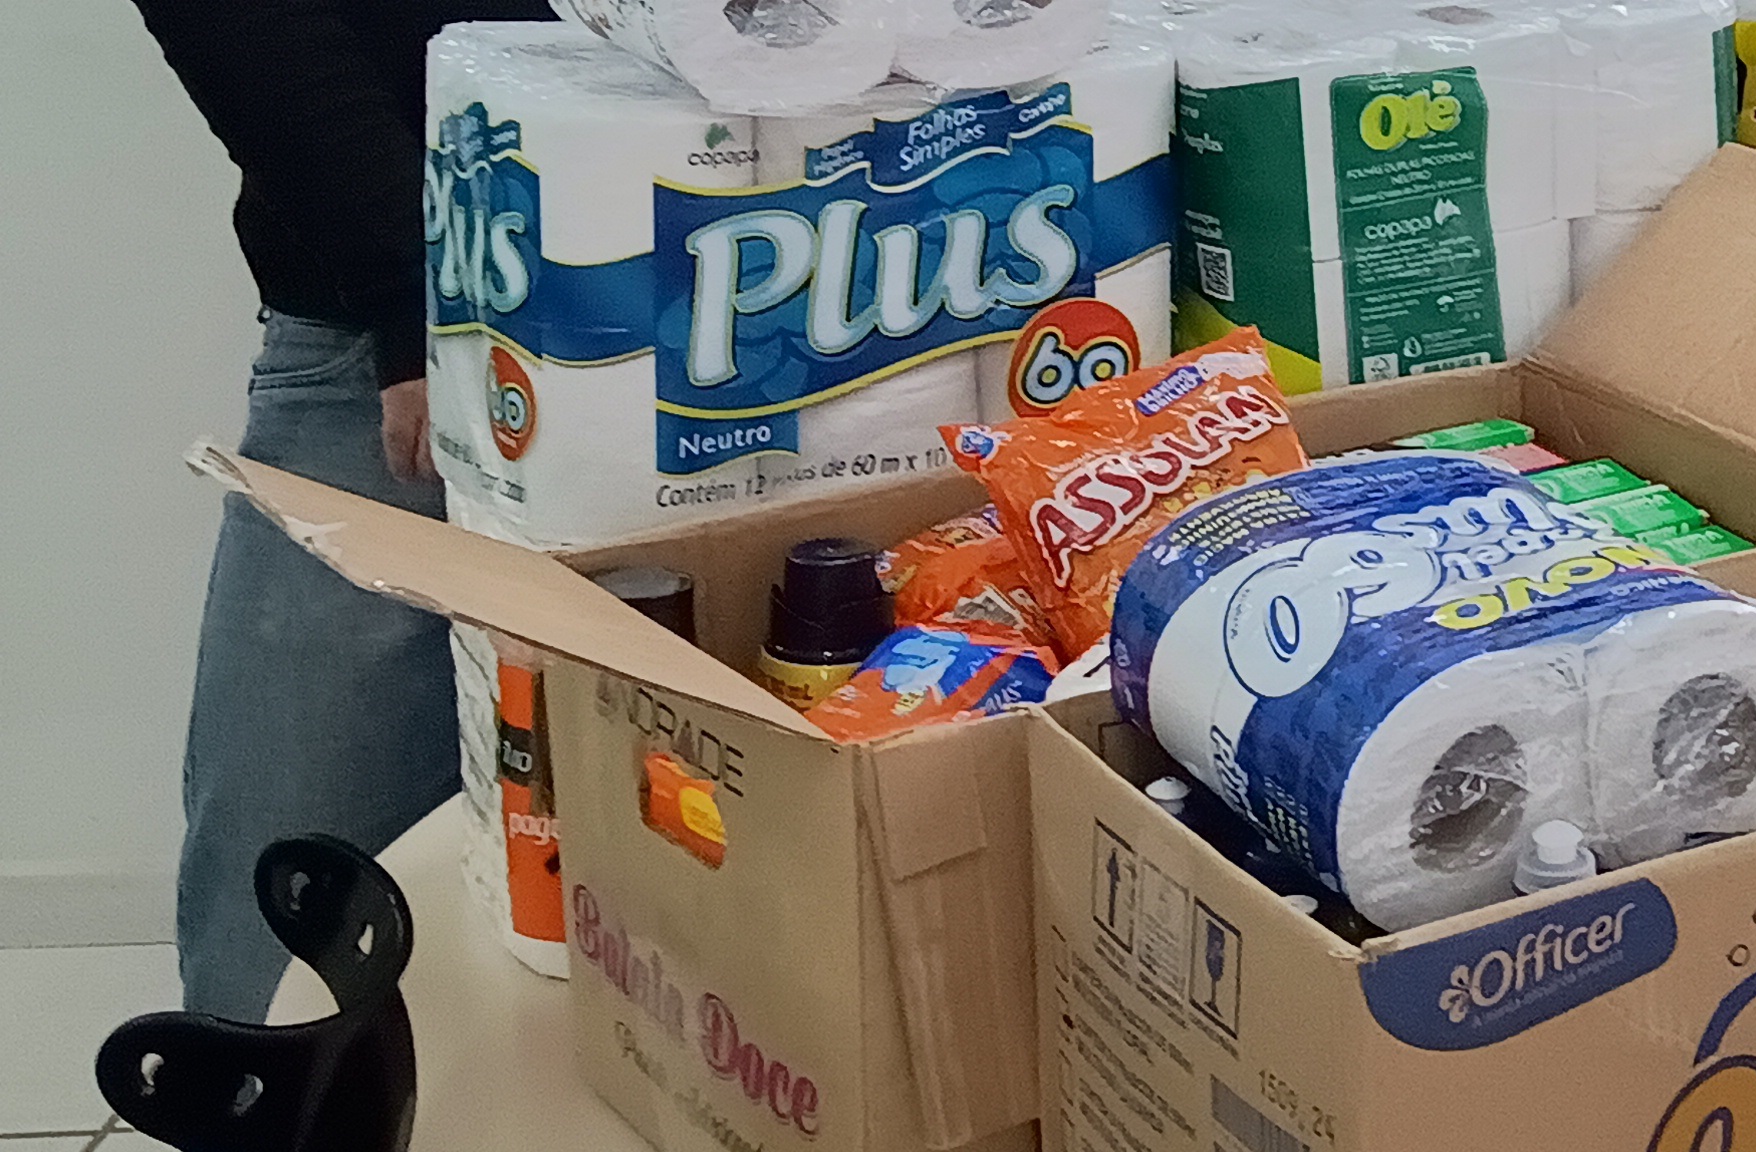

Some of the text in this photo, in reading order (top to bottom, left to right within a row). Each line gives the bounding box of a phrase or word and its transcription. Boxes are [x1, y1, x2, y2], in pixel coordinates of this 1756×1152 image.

[899, 122, 987, 172] Simples
[908, 103, 977, 146] Folhas
[1358, 79, 1463, 152] Olé
[685, 183, 1080, 387] Plus
[1018, 325, 1132, 409] 60
[678, 424, 772, 459] Neutro
[1029, 384, 1290, 589] ASSOLAN
[1223, 529, 1446, 700] 60
[1469, 900, 1636, 1011] Officer
[695, 989, 822, 1142] Doce
